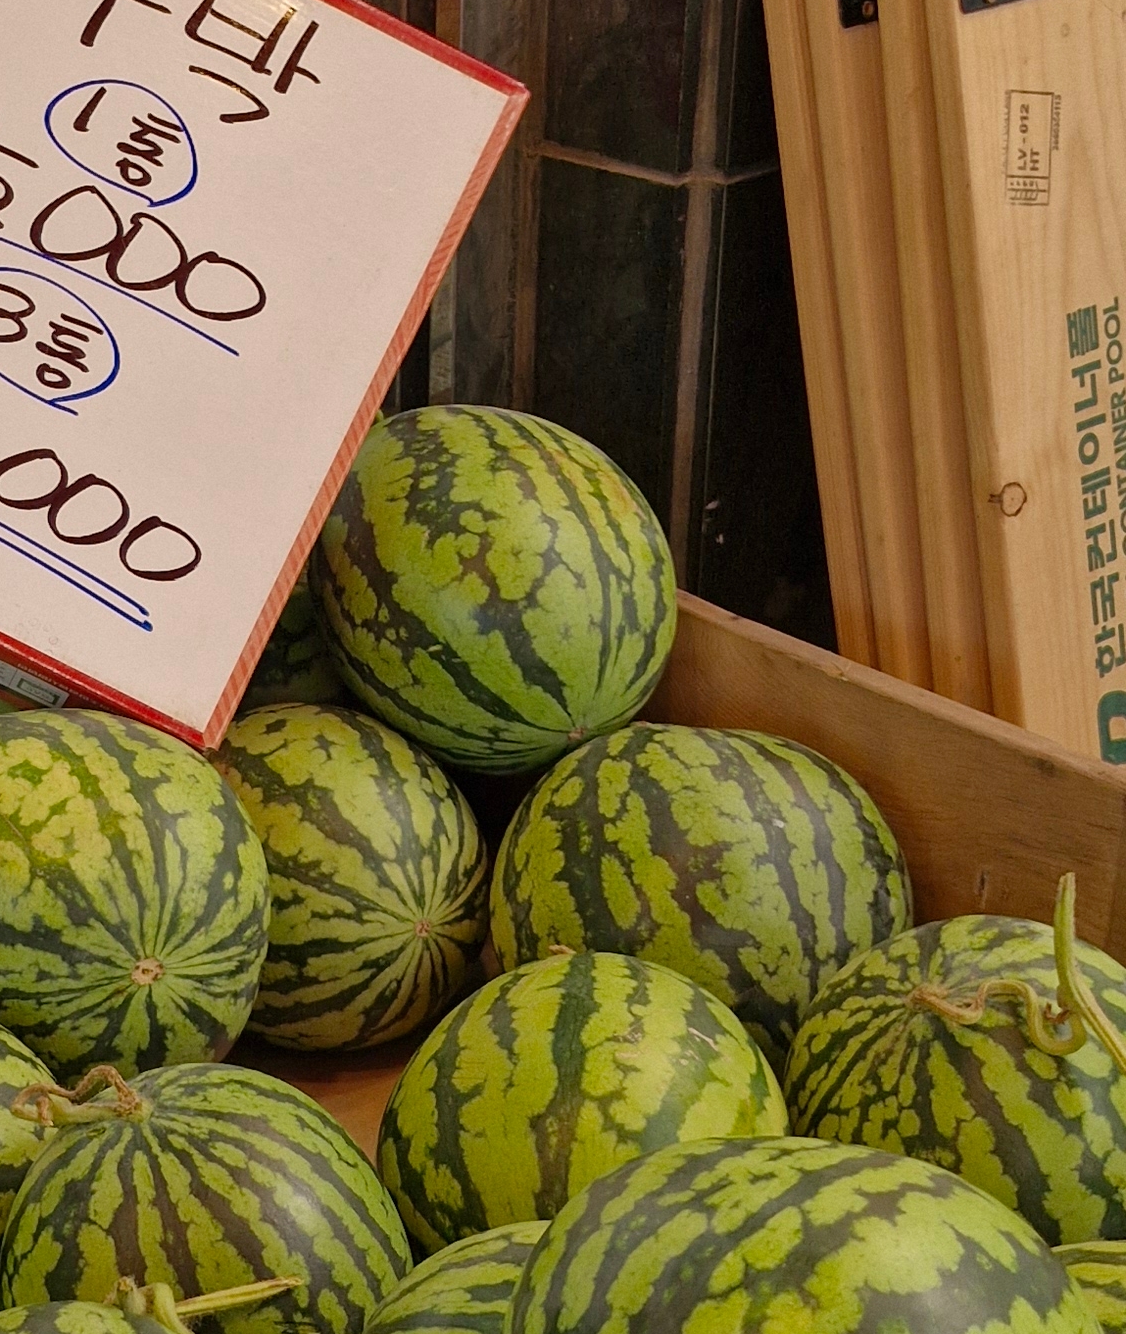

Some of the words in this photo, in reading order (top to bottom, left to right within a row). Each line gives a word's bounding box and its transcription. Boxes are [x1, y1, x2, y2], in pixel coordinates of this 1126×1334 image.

[73, 86, 185, 187] 1통
[1029, 148, 1040, 172] HT
[1103, 296, 1126, 384] POOL
[1066, 304, 1126, 678] 한국컨테이너풀
